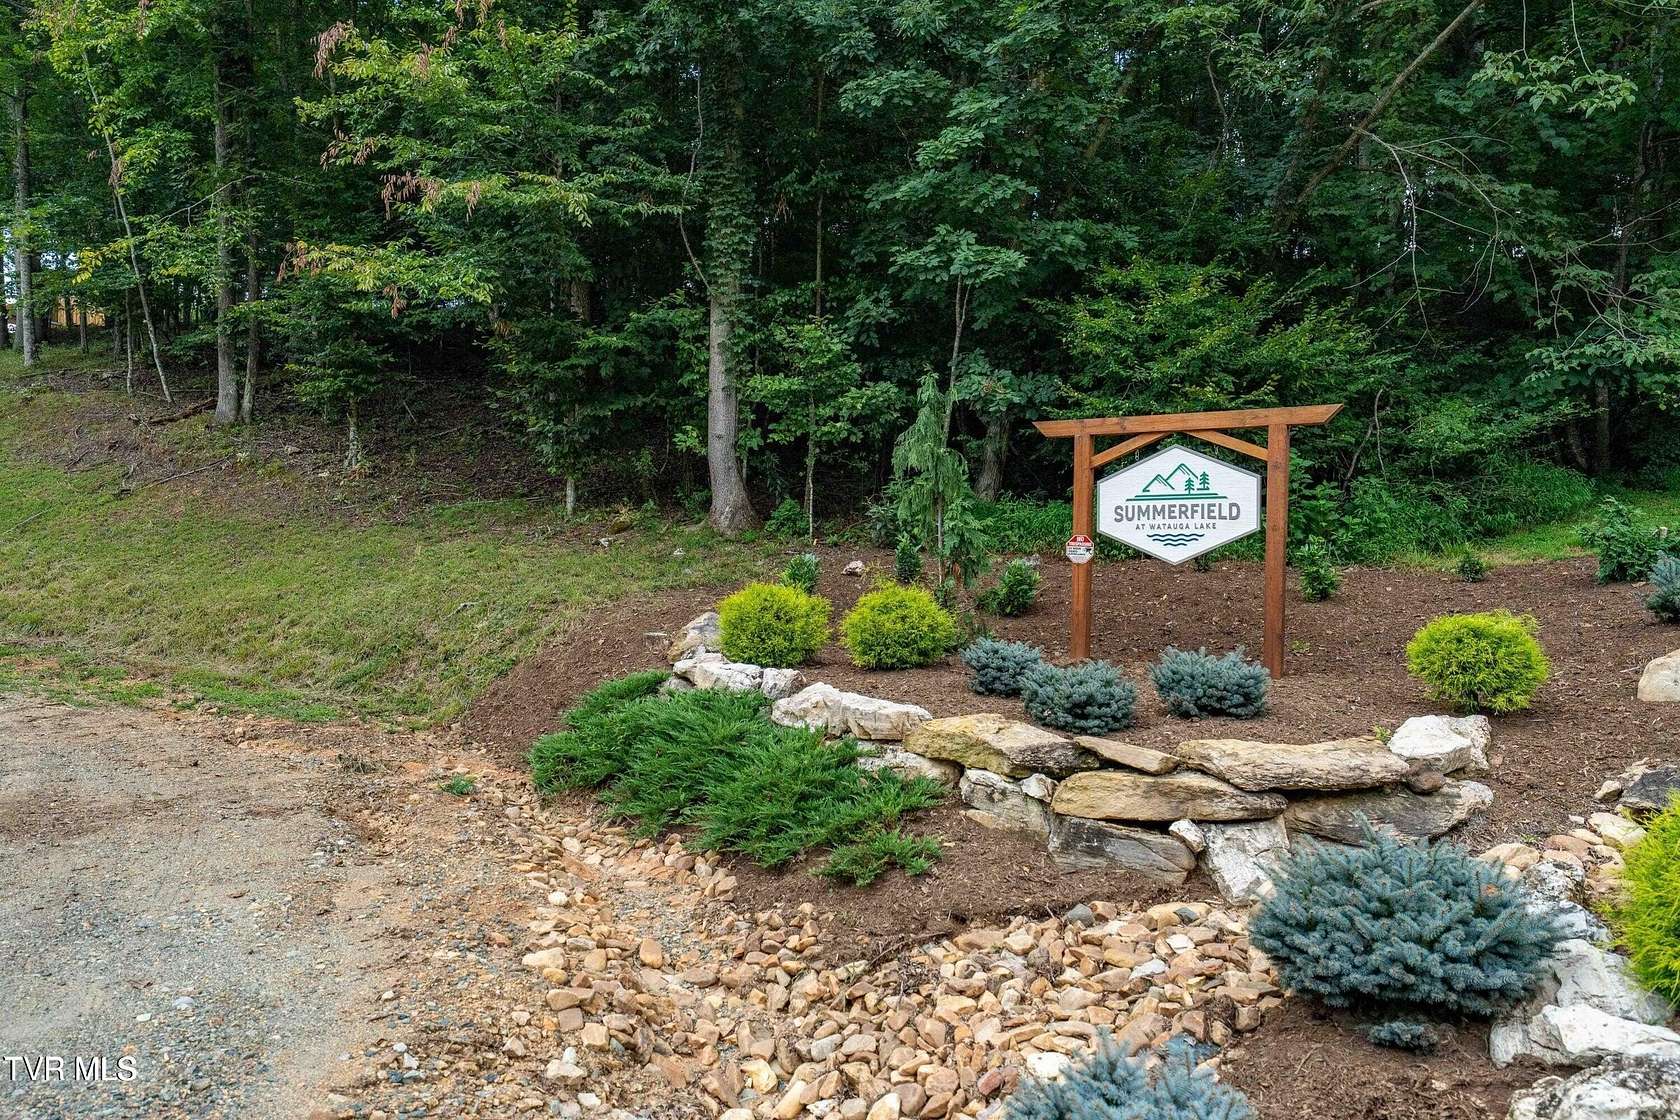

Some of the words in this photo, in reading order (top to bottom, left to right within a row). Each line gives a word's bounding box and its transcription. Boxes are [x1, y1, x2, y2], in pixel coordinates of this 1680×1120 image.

[1114, 502, 1241, 523] SUMMERFIELD
[1149, 523, 1191, 531] WATAUGA
[1194, 522, 1217, 530] LAKE
